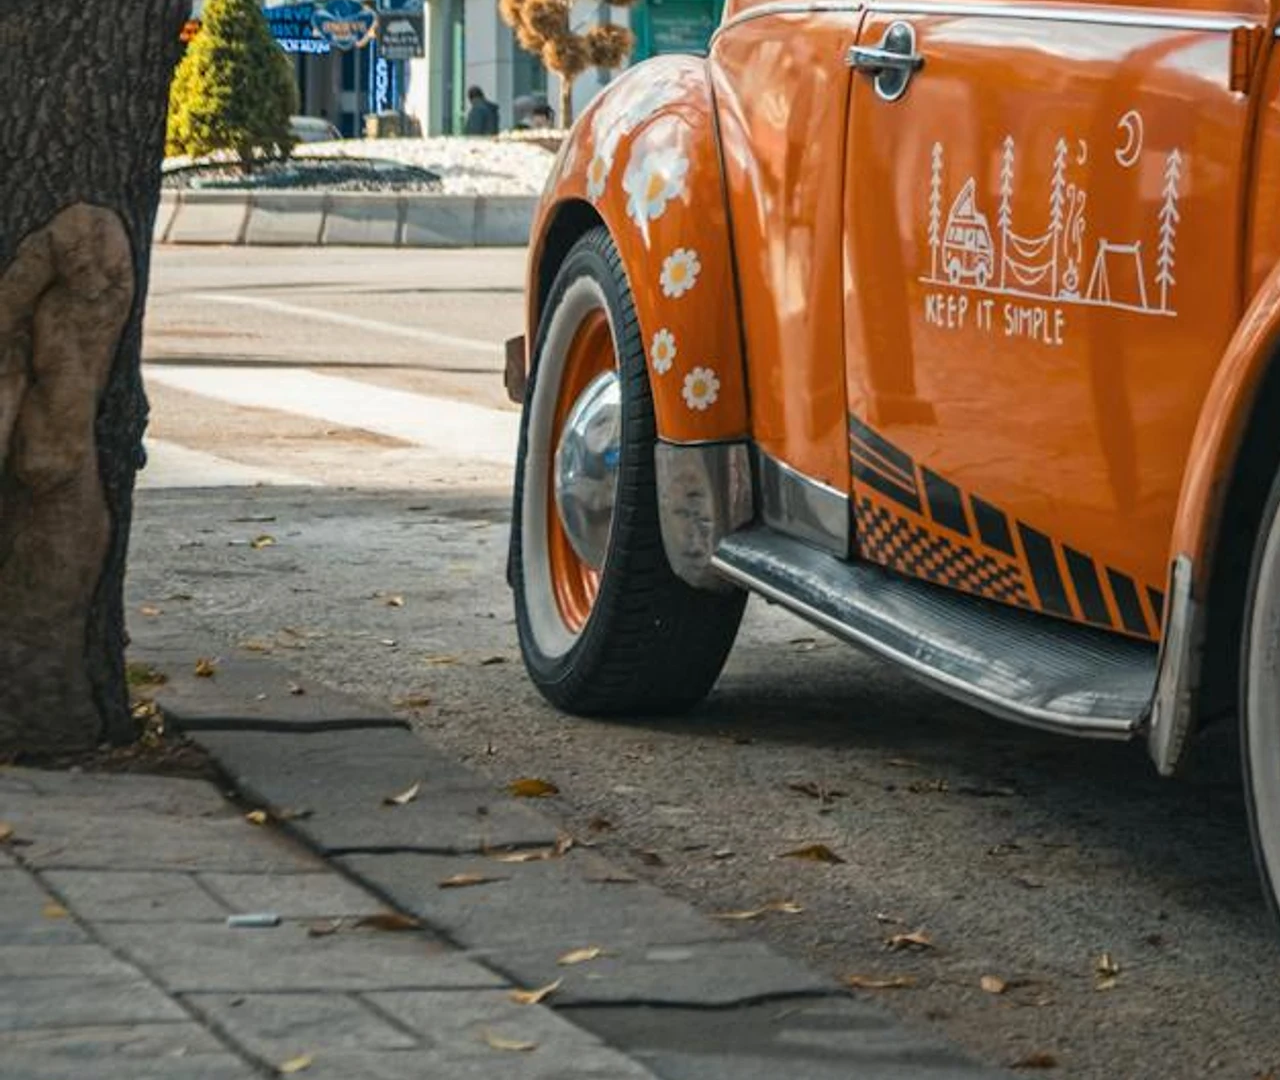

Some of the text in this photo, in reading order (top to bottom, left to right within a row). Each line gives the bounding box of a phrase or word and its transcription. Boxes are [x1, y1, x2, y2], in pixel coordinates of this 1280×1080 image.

[926, 294, 1065, 345] KEEP IT SIMPLE
